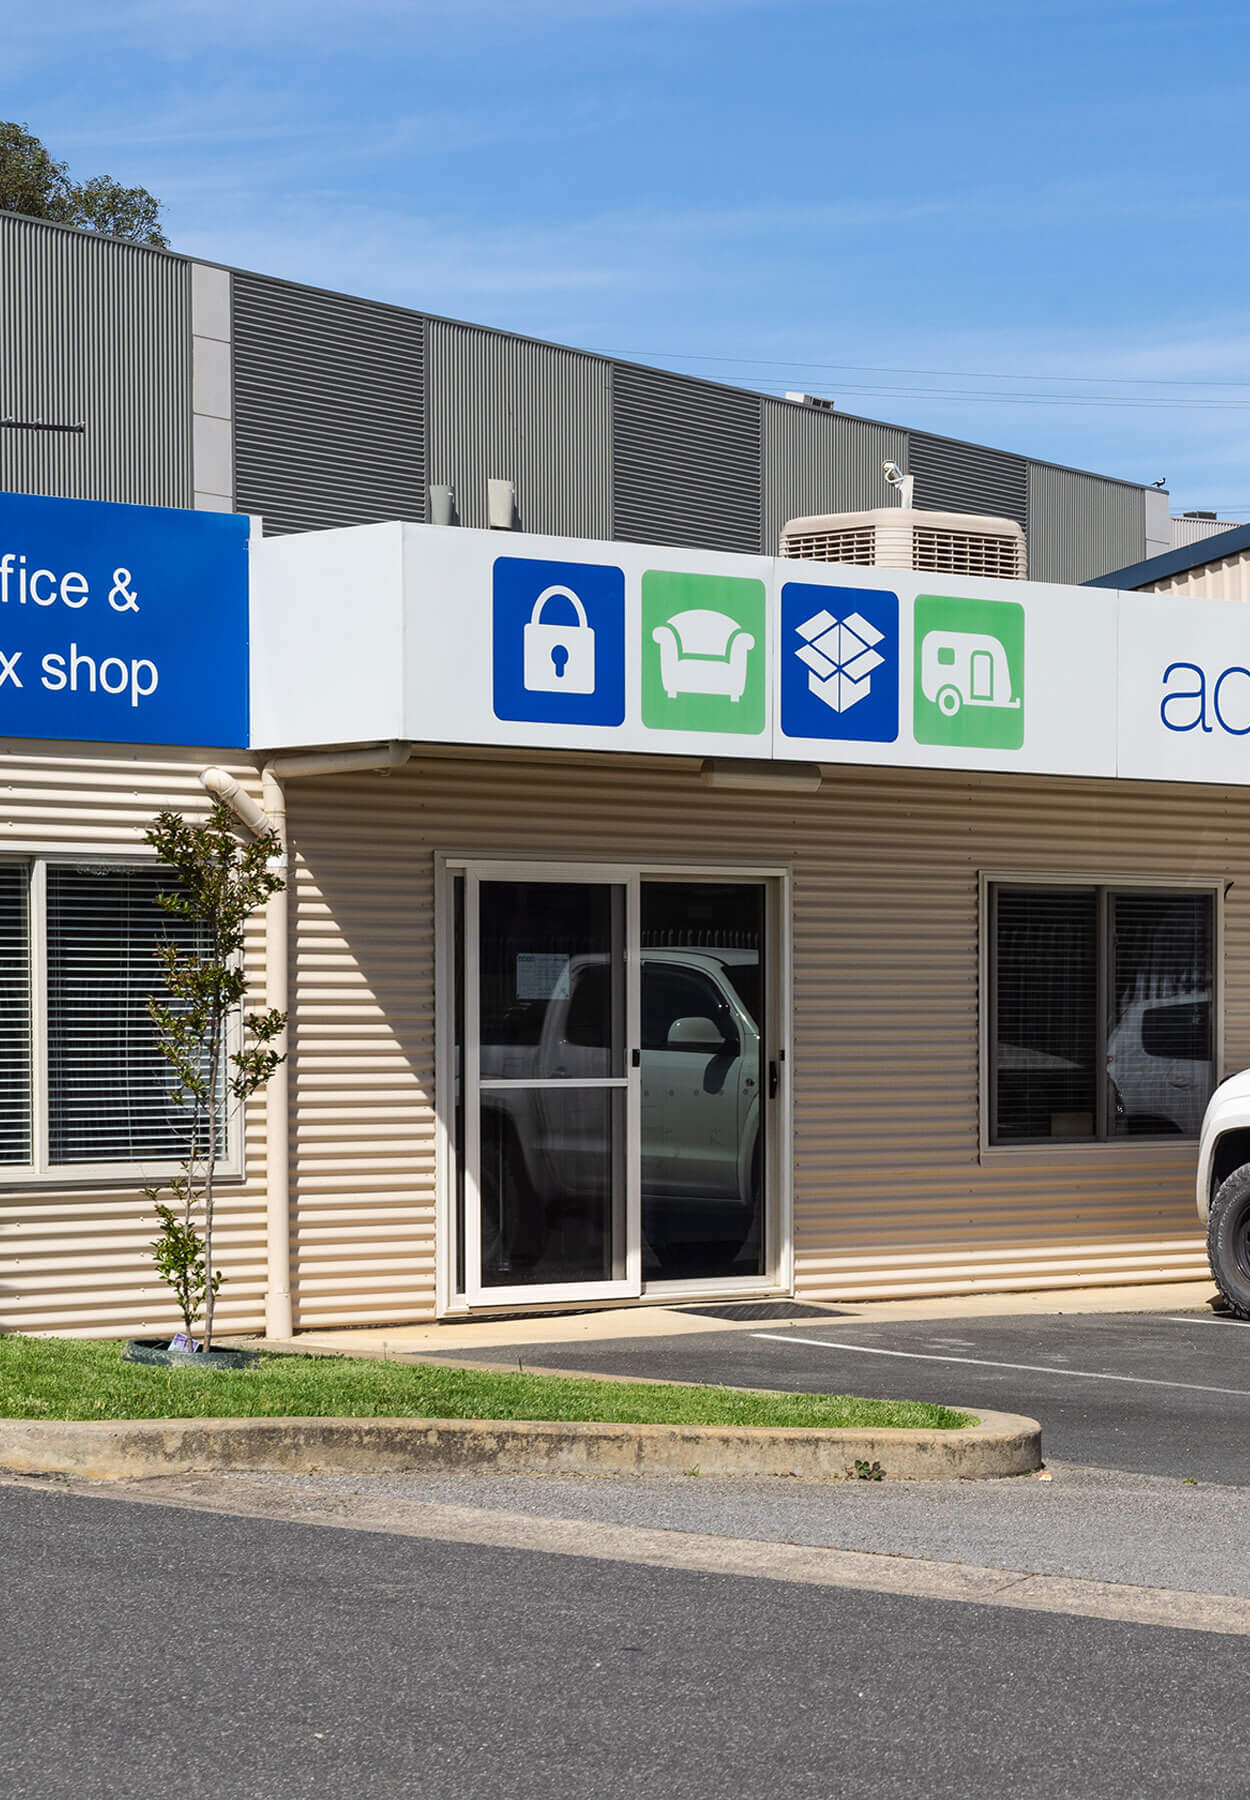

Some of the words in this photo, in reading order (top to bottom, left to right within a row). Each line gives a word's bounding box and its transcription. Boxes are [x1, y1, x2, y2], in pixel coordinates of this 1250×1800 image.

[0, 553, 89, 609] fice
[108, 567, 140, 613] &
[0, 651, 24, 688] x
[41, 642, 159, 707] shop
